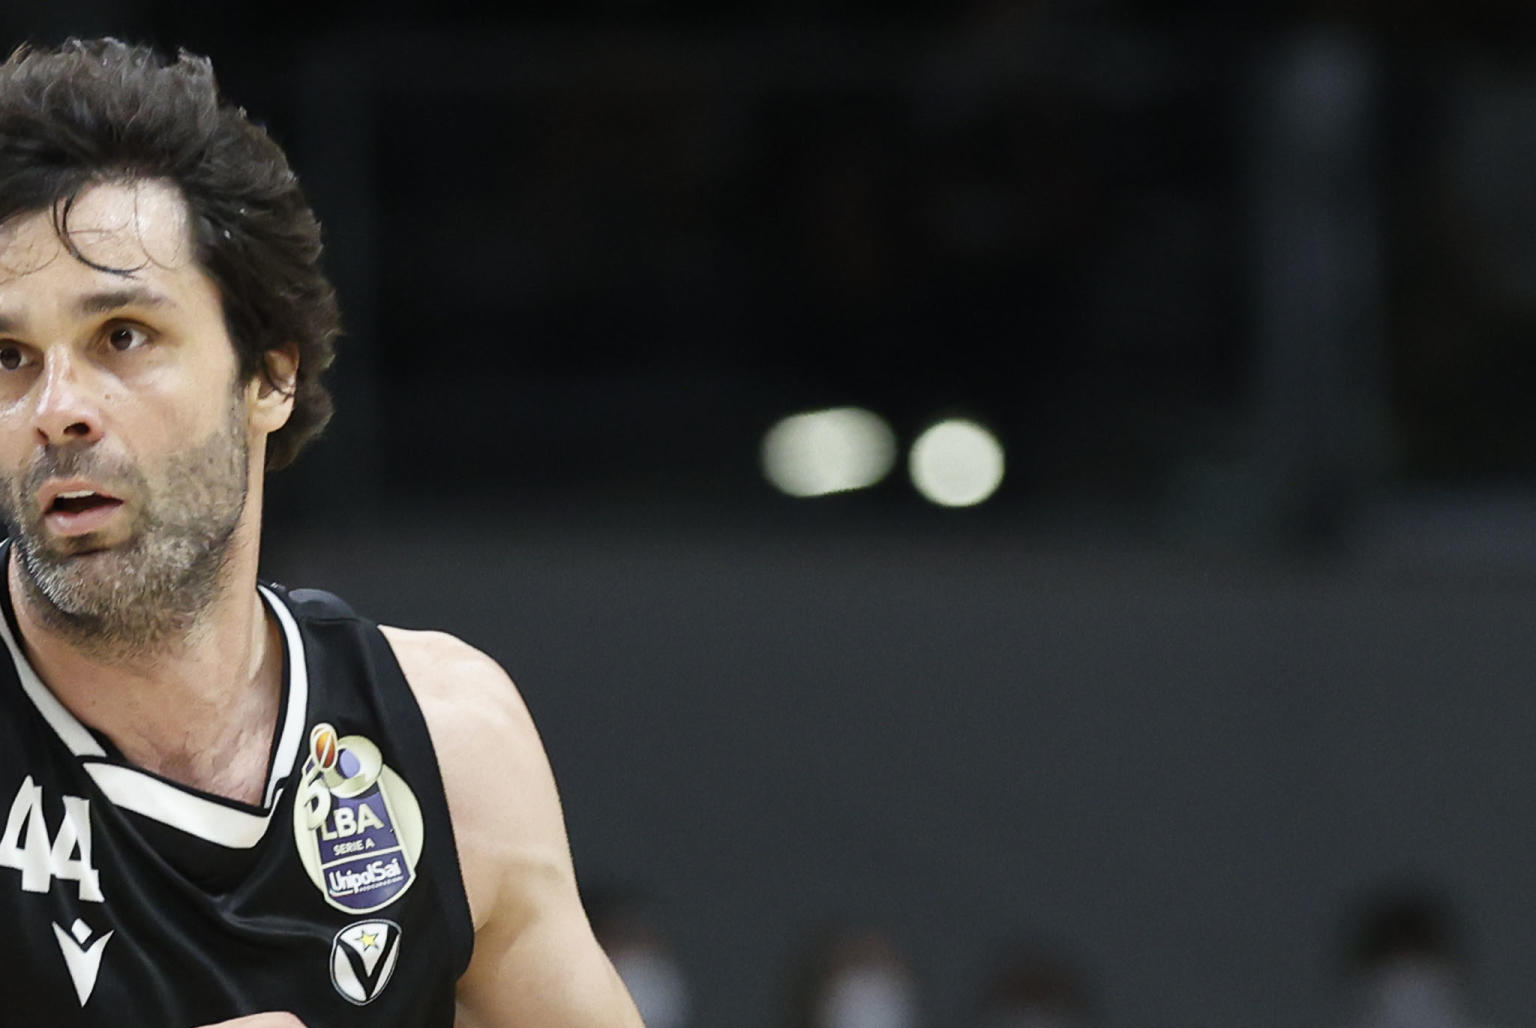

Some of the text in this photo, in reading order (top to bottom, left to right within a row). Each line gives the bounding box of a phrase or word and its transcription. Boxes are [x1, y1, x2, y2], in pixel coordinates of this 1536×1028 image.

[321, 803, 385, 841] LBA
[333, 838, 376, 856] SERIE A
[328, 858, 402, 894] UnipolSai
